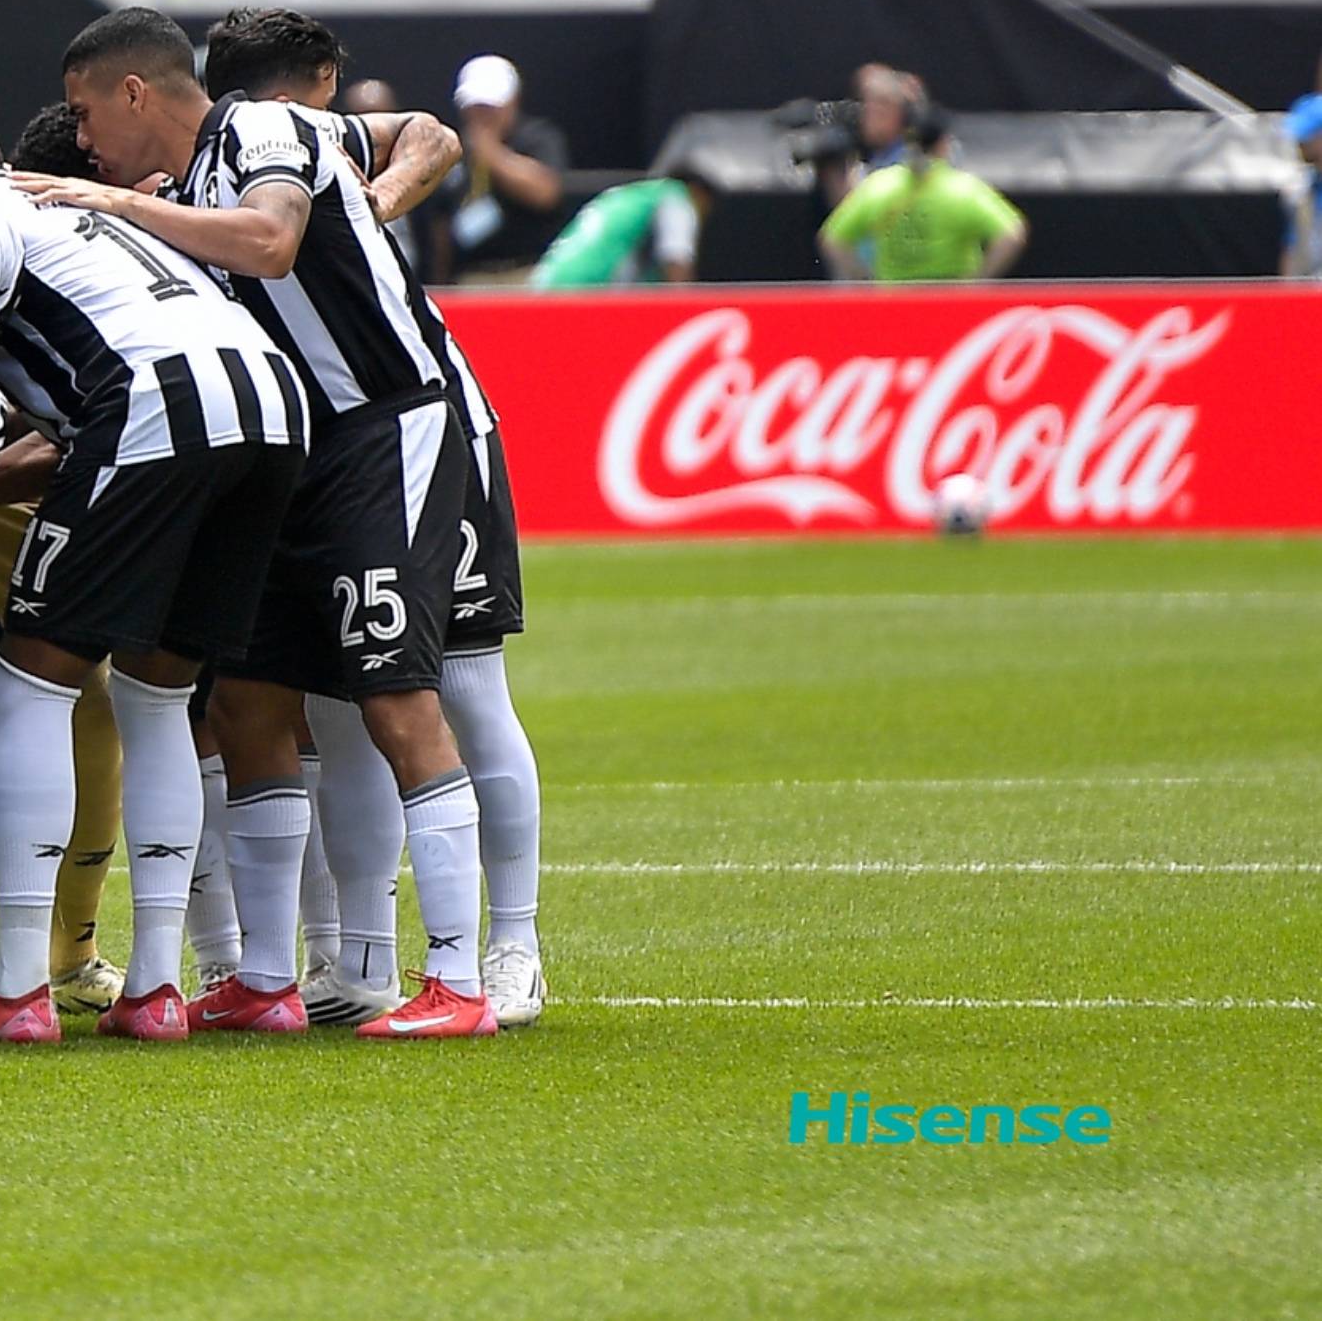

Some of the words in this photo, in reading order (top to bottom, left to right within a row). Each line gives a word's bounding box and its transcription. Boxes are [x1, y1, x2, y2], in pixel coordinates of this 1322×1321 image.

[598, 305, 1232, 527] Coca-Cola
[11, 517, 71, 593] 17
[453, 518, 488, 593] 2
[333, 567, 407, 648] 25
